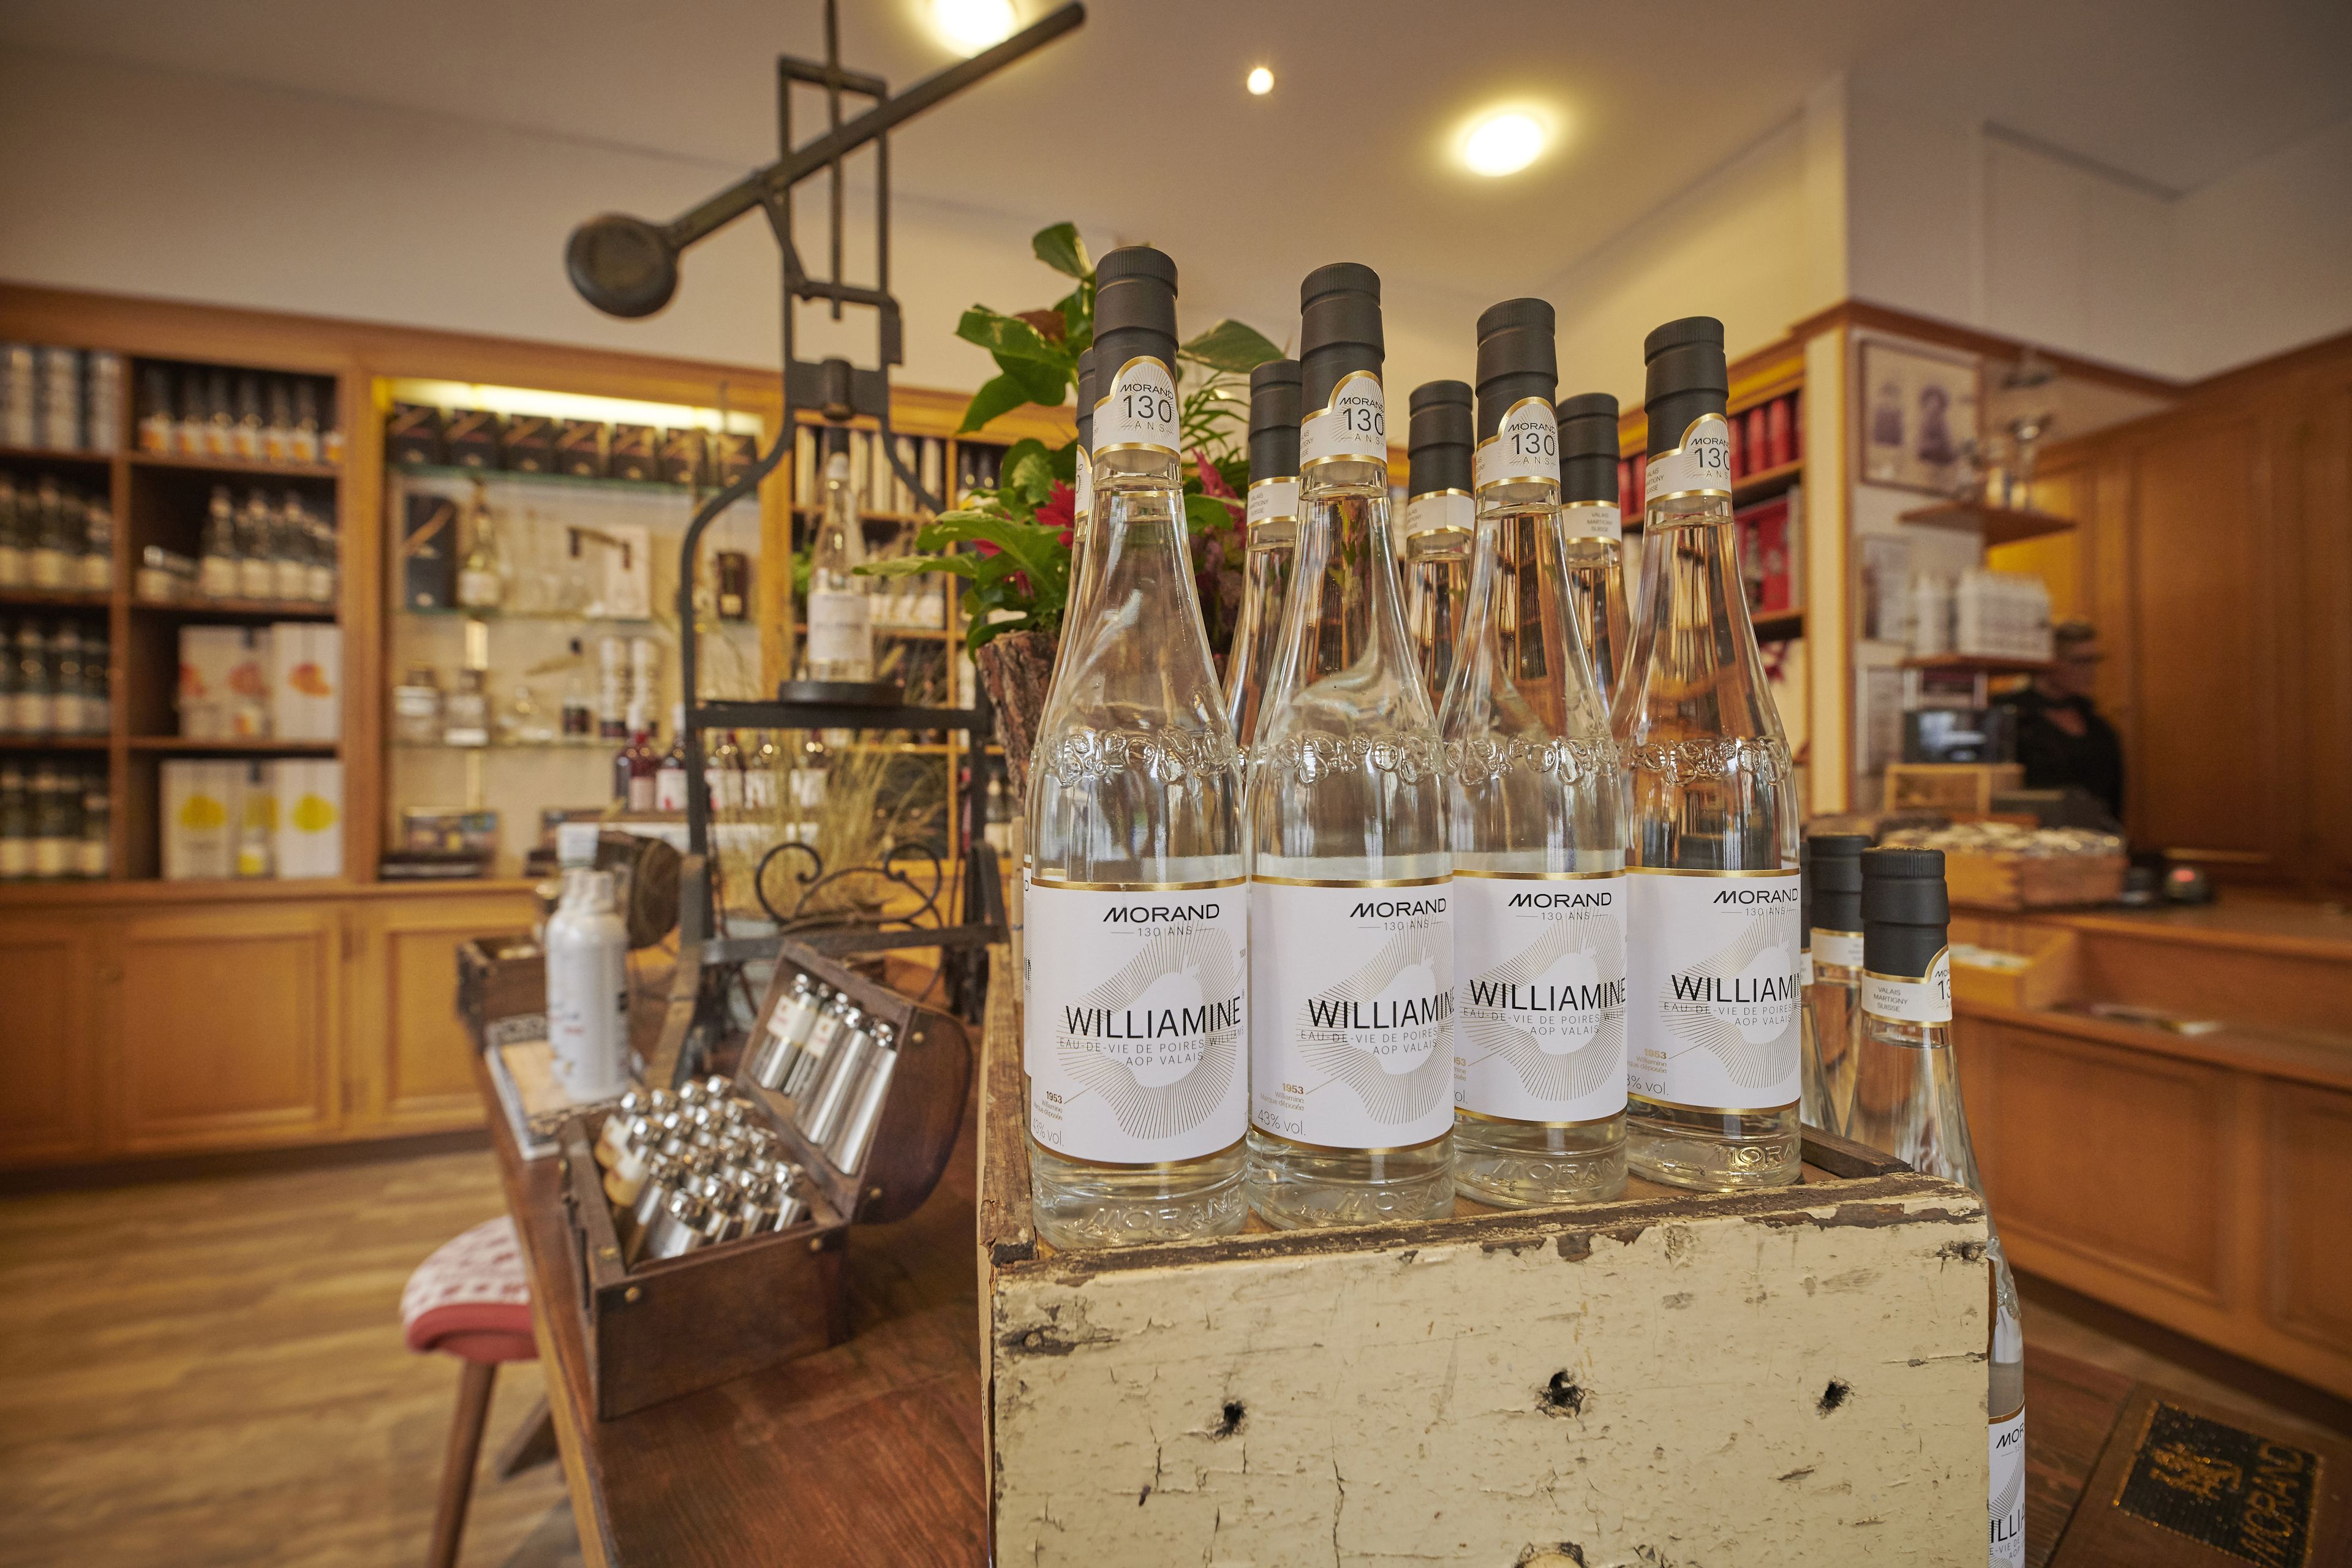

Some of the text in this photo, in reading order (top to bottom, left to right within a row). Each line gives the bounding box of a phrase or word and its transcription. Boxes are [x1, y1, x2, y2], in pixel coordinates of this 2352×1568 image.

[1120, 383, 1173, 399] MORAND
[1123, 395, 1171, 423] 130
[1136, 421, 1164, 432] ANS
[1343, 408, 1384, 436] 130
[1508, 423, 1556, 434] MORAND
[1355, 433, 1380, 445] ANS
[1511, 433, 1555, 456] 130
[1691, 437, 1729, 448] MORAN
[1523, 456, 1550, 465] ANS
[1694, 448, 1730, 470] 130
[1706, 470, 1728, 480] ANS
[1508, 892, 1611, 908] MORAND
[1713, 888, 1798, 905] MORAND
[1103, 903, 1219, 923] MORAND
[1350, 898, 1446, 918] MORAND
[1745, 907, 1785, 916] 130 ANS
[1541, 911, 1590, 921] 130 ANS
[1138, 925, 1192, 937] 130 ANS
[1384, 919, 1430, 931] 130 ANS
[1470, 977, 1626, 1012] WILLIAMINE
[1878, 986, 1901, 996] VALAIS
[1874, 993, 1908, 1005] MARTIGNY
[1664, 1002, 1737, 1016] EAU-DE-VIE
[1744, 1006, 1757, 1016] DE
[1763, 1004, 1792, 1015] POIRES
[1877, 1002, 1900, 1012] SUISSE
[1463, 1008, 1532, 1024] EAU-DE-VIE
[1540, 1016, 1555, 1024] DE
[1561, 1013, 1600, 1024] POIRES
[1735, 1014, 1792, 1027] AOP VALAIS
[1300, 1030, 1376, 1044] EAU-DE-VIE
[1383, 1033, 1396, 1042] DE
[1403, 1027, 1437, 1041] POIRES
[1530, 1025, 1599, 1036] AOP VALAIS
[1060, 1026, 1244, 1054] EAU-DE-VIE DE POIRES WILLIAMS
[1373, 1039, 1437, 1055] AOP VALAIS
[1126, 1051, 1204, 1066] AOP VALAIS
[1644, 1048, 1667, 1060] 1953
[1454, 1057, 1466, 1066] 53
[1636, 1055, 1667, 1067] Williamine
[1640, 1063, 1667, 1074] déposée
[1282, 1083, 1303, 1095] 1953
[1627, 1074, 1668, 1096] 3% vol.
[1046, 1091, 1062, 1104] 1953
[1275, 1091, 1304, 1103] Williamine
[1454, 1089, 1468, 1104] ol.
[1278, 1099, 1304, 1111] déposée
[1257, 1109, 1280, 1129] 43%
[1284, 1120, 1306, 1136] vol.
[1033, 1117, 1064, 1147] 43% vol.
[1996, 1422, 2024, 1449] MOR
